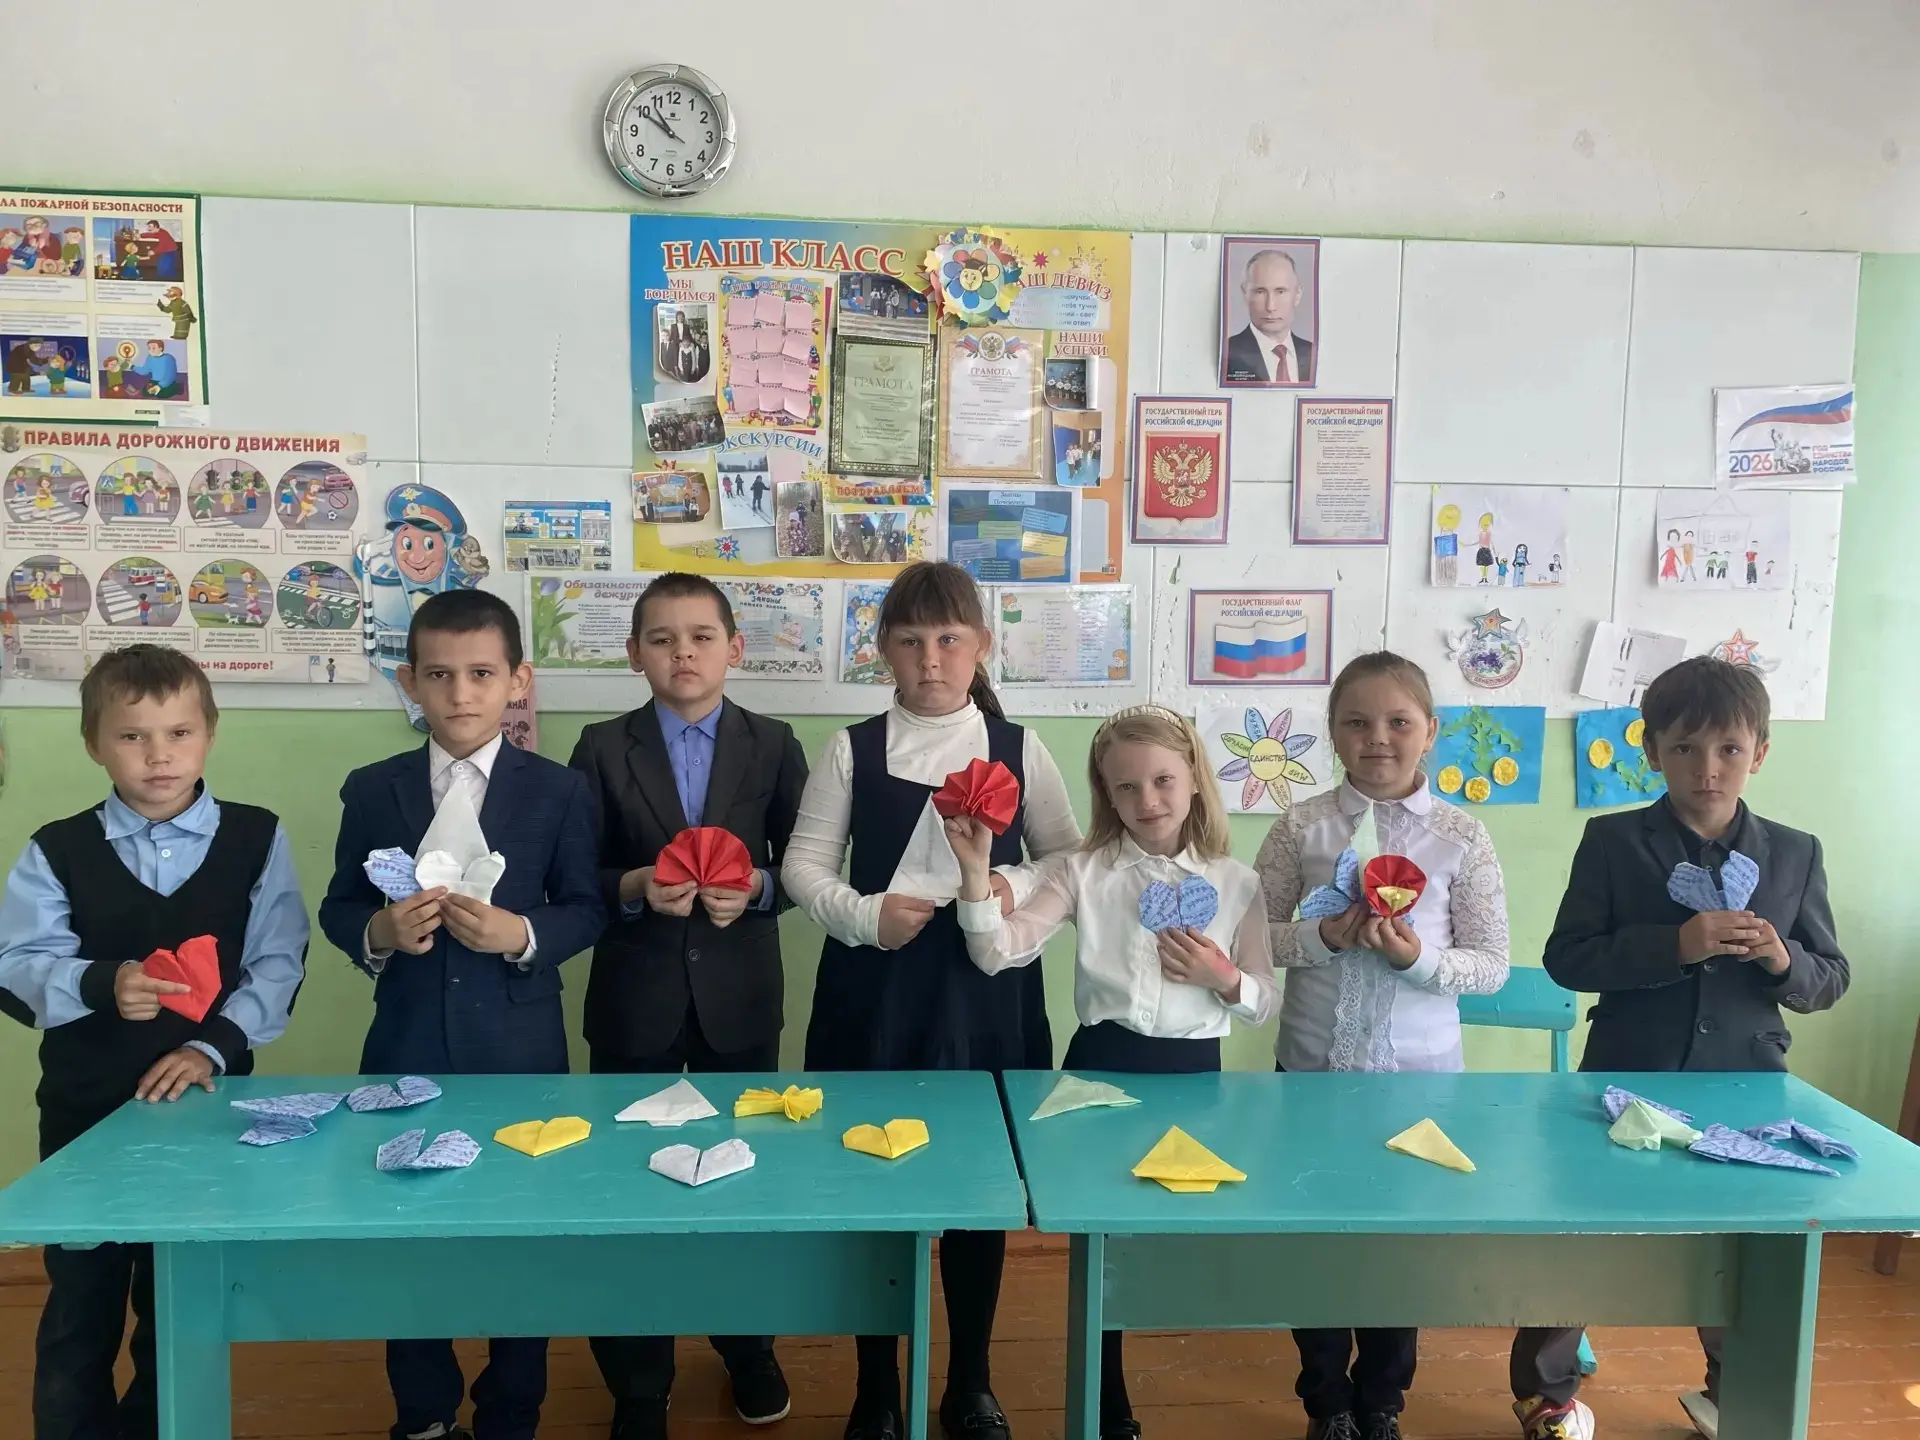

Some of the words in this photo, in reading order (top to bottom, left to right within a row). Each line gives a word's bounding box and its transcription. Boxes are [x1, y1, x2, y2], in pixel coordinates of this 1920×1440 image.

[651, 95, 663, 108] 11
[666, 91, 681, 105] 12
[688, 98, 695, 111] 1
[637, 105, 651, 119] 10
[700, 111, 709, 124] 2
[630, 124, 639, 137] 9
[705, 131, 714, 144] 3
[636, 144, 645, 157] 8
[697, 150, 706, 162] 4
[650, 158, 659, 171] 7
[666, 163, 675, 176] 6
[684, 161, 693, 173] 5
[20, 198, 89, 210] ПОЖАРНОЙ
[92, 201, 183, 213] БЕЗОПАСНОСТИ
[662, 240, 762, 270] НАШ
[771, 240, 907, 277] КЛАСС
[669, 279, 693, 289] МЫ
[1016, 273, 1047, 288] АШ
[1051, 273, 1112, 300] ДЕВИЗ
[645, 289, 716, 301] ГОРДИМСЯ
[1059, 332, 1105, 343] НАШИ
[1054, 345, 1107, 357] УСПЕХИ
[971, 367, 1013, 376] ГРАМОТА
[853, 377, 914, 391] ГРАМОТА
[1145, 407, 1207, 417] ГОСУДАРСТВЕННЫЙ
[1208, 408, 1223, 417] ГЕРБ
[1307, 407, 1366, 416] ГОСУДАРСТВЕННЫЙ
[1367, 407, 1383, 416] ГИМН
[1145, 417, 1186, 427] РОССИЙСКОЙ
[1186, 418, 1223, 427] ФЕДЕРАЦИИ
[1306, 417, 1347, 426] РОССИЙСКОЙ
[1347, 418, 1384, 427] ФЕДЕРАЦИИ
[24, 430, 112, 448] ПРАВИЛА
[116, 433, 231, 450] ДОРОЖНОГО
[236, 436, 340, 453] ДВИЖЕНИЯ
[716, 432, 823, 458] ЭКСКУРСИИ
[1729, 454, 1773, 474] 2026
[1813, 458, 1849, 466] НАРОДОВ
[594, 590, 641, 601] дежурн
[1222, 597, 1285, 607] ГОСУДАРСТВЕННЫЙ
[1285, 598, 1303, 607] ФЛАГ
[1221, 607, 1264, 617] РОССИЙСКОЙ
[1264, 608, 1303, 618] ФЕДЕРАЦИИ
[213, 661, 227, 670] на
[229, 660, 273, 671] дороге!
[1250, 754, 1286, 763] ЕДИНСТВО
[1288, 769, 1308, 782] МИР
